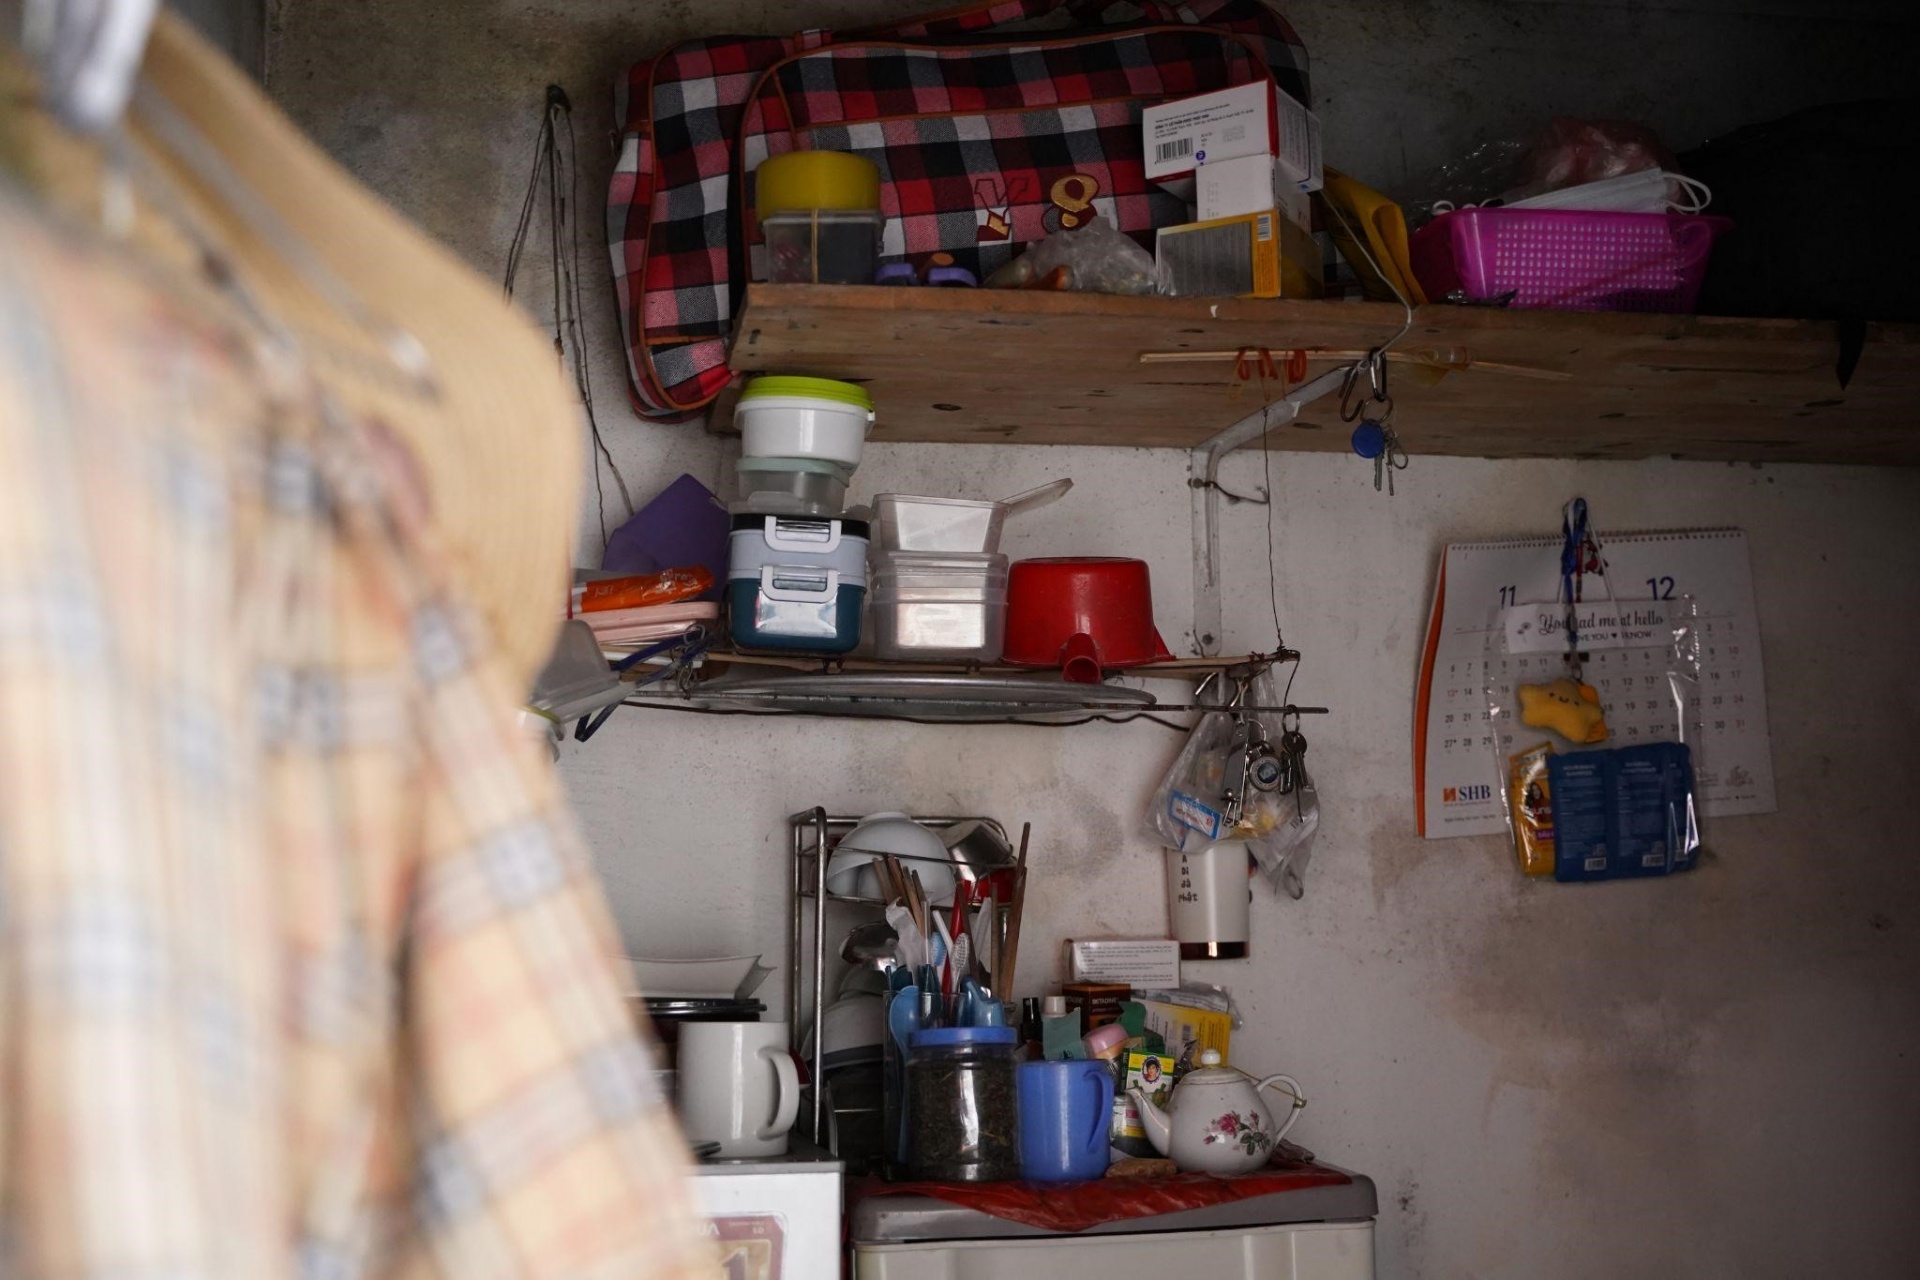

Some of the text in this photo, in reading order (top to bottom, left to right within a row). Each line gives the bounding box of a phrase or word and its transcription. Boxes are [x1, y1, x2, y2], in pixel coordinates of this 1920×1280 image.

[1646, 576, 1676, 600] 12
[1499, 585, 1516, 610] 11
[1599, 616, 1617, 628] me
[1620, 612, 1631, 628] at
[1634, 610, 1663, 627] hello
[1592, 632, 1608, 642] YOU
[1519, 659, 1528, 667] 10
[1540, 658, 1548, 666] 11
[1601, 679, 1610, 687] 11
[1623, 677, 1633, 686] 12
[1710, 672, 1720, 680] 16
[1464, 688, 1472, 696] 14
[1501, 685, 1510, 693] 16
[1625, 702, 1635, 710] 19
[1647, 700, 1657, 709] 20
[1690, 698, 1701, 707] 22
[1712, 696, 1723, 705] 23
[1733, 694, 1744, 703] 24
[1445, 711, 1511, 723] 20 21 22 23
[1628, 726, 1638, 735] 26
[1715, 720, 1725, 729] 30
[1736, 719, 1746, 728] 31
[1463, 738, 1472, 747] 28
[1483, 737, 1492, 745] 29
[1502, 735, 1513, 744] 30
[1459, 785, 1491, 801] SHB
